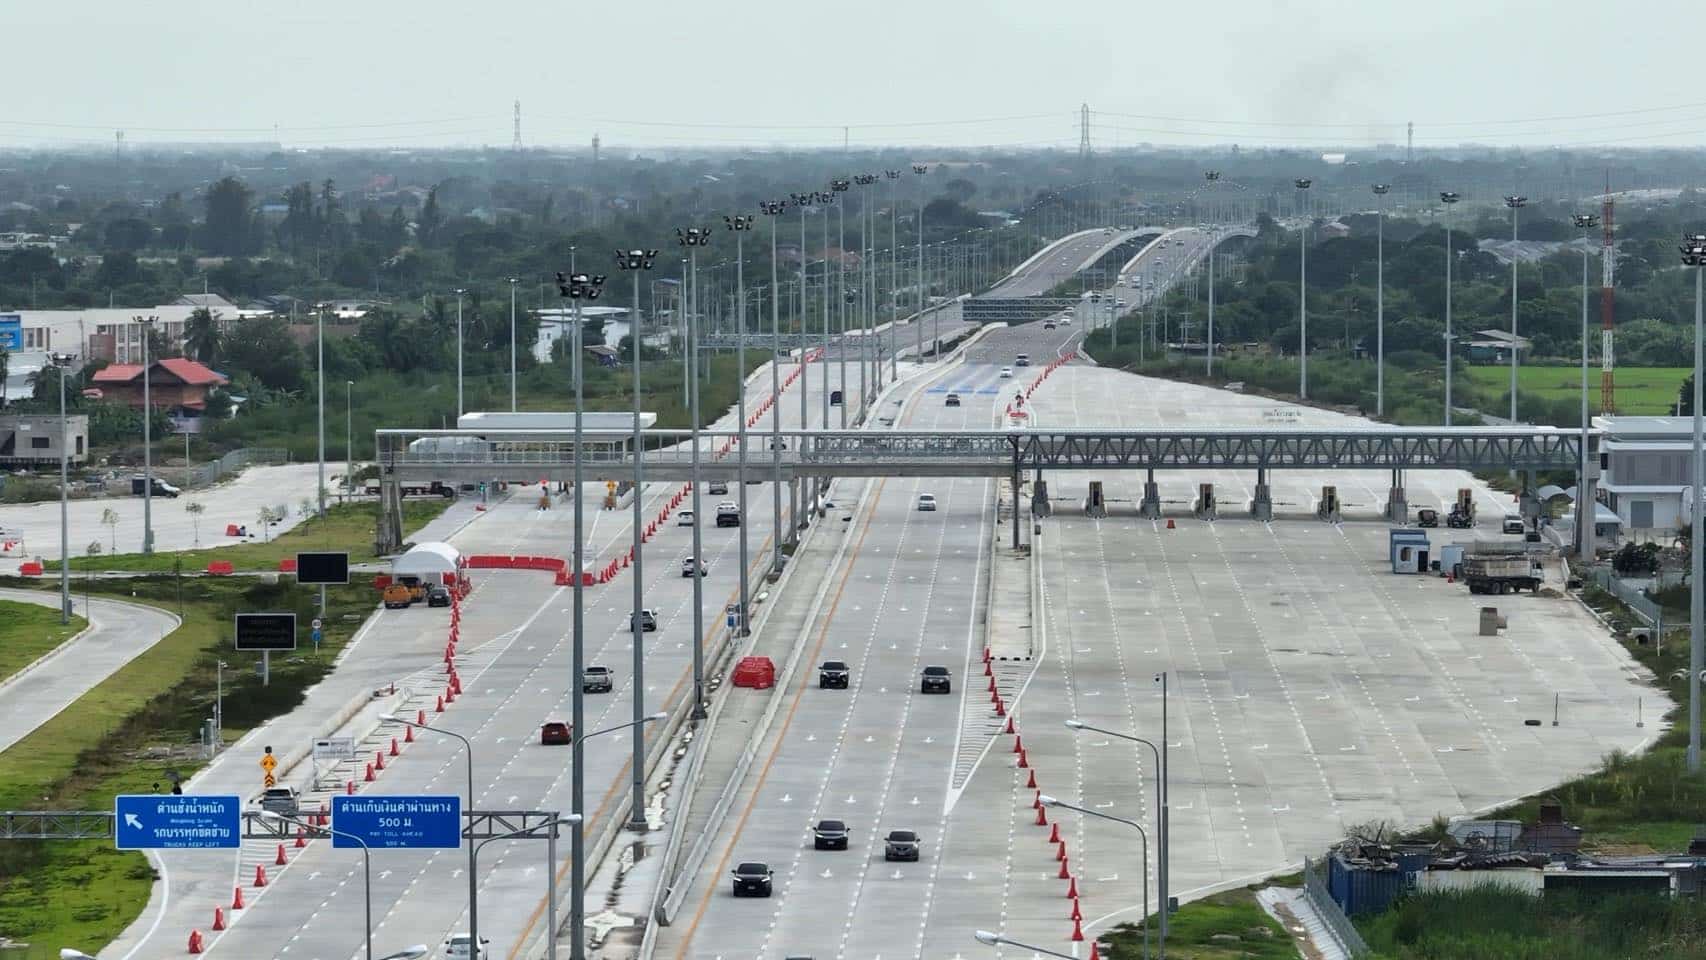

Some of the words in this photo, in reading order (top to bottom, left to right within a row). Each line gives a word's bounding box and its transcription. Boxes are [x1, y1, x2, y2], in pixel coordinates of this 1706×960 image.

[342, 800, 451, 813] ด่านเก็บเงินค่าผ่านทาง
[379, 817, 400, 827] 500
